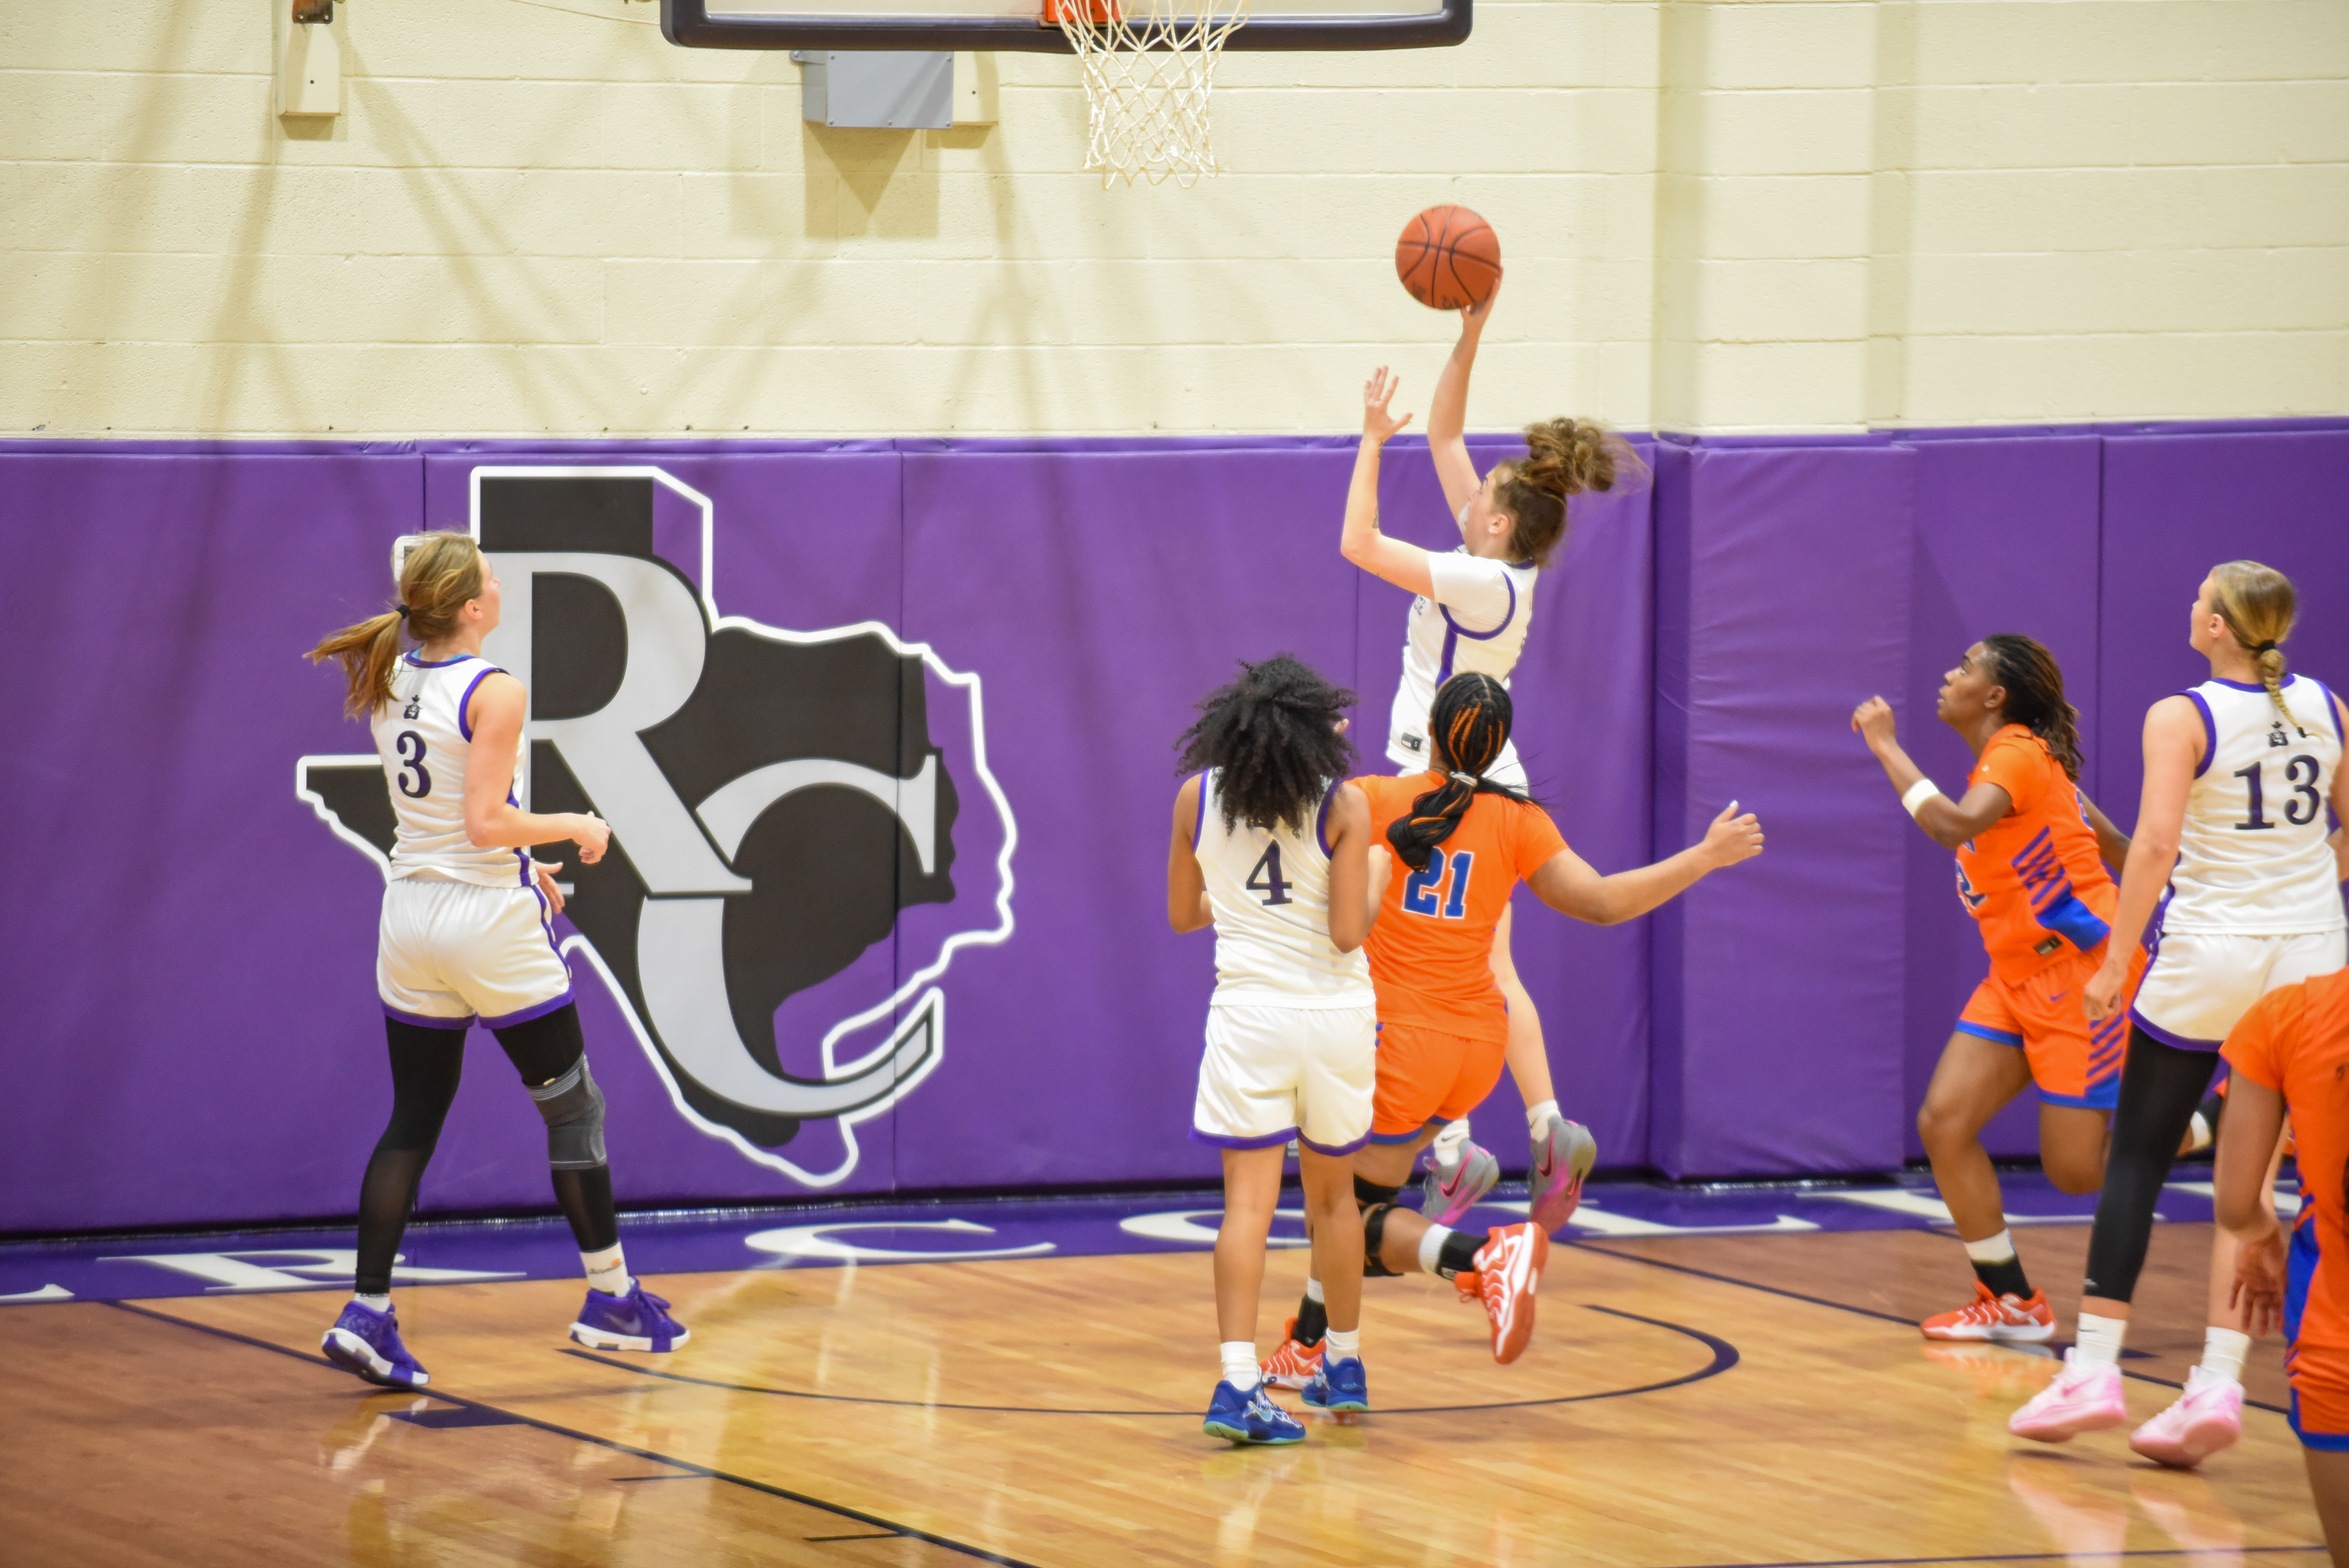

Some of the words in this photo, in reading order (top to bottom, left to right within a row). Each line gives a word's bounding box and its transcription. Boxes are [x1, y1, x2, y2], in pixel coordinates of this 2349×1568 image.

[397, 731, 431, 799] 3
[2234, 755, 2320, 830] 13
[478, 552, 936, 1115] RC
[1246, 839, 1293, 906] 4
[1401, 846, 1475, 919] 21
